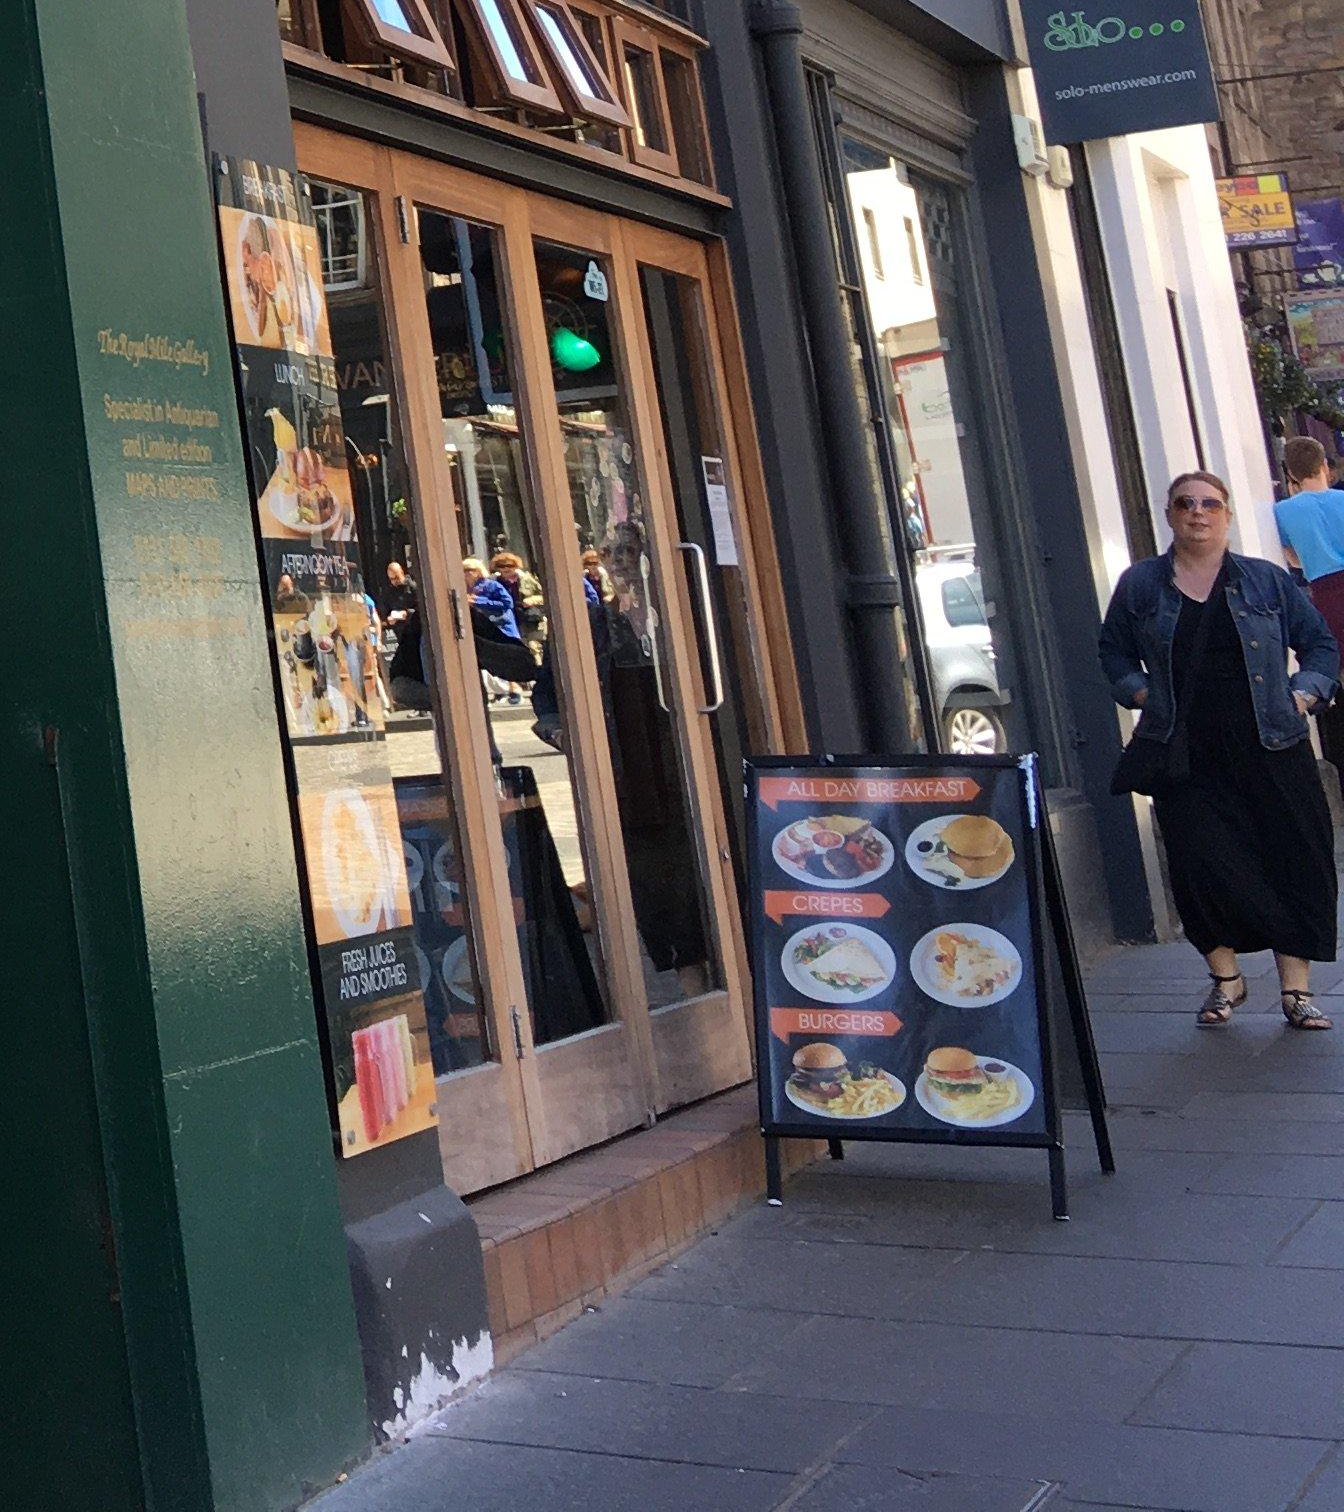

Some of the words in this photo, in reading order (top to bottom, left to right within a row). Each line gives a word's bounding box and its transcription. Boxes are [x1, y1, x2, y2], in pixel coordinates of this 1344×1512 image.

[1054, 69, 1197, 101] solo-menswear.com
[787, 779, 821, 797] ALL
[824, 780, 864, 798] DAY
[866, 779, 968, 798] BREAKFAST
[791, 895, 864, 914] CREPES
[341, 948, 369, 974] FRESH
[369, 940, 396, 969] JUICES
[340, 974, 360, 1000] AND
[360, 962, 408, 995] SMOOTHIES
[798, 1012, 885, 1033] BURGERS
